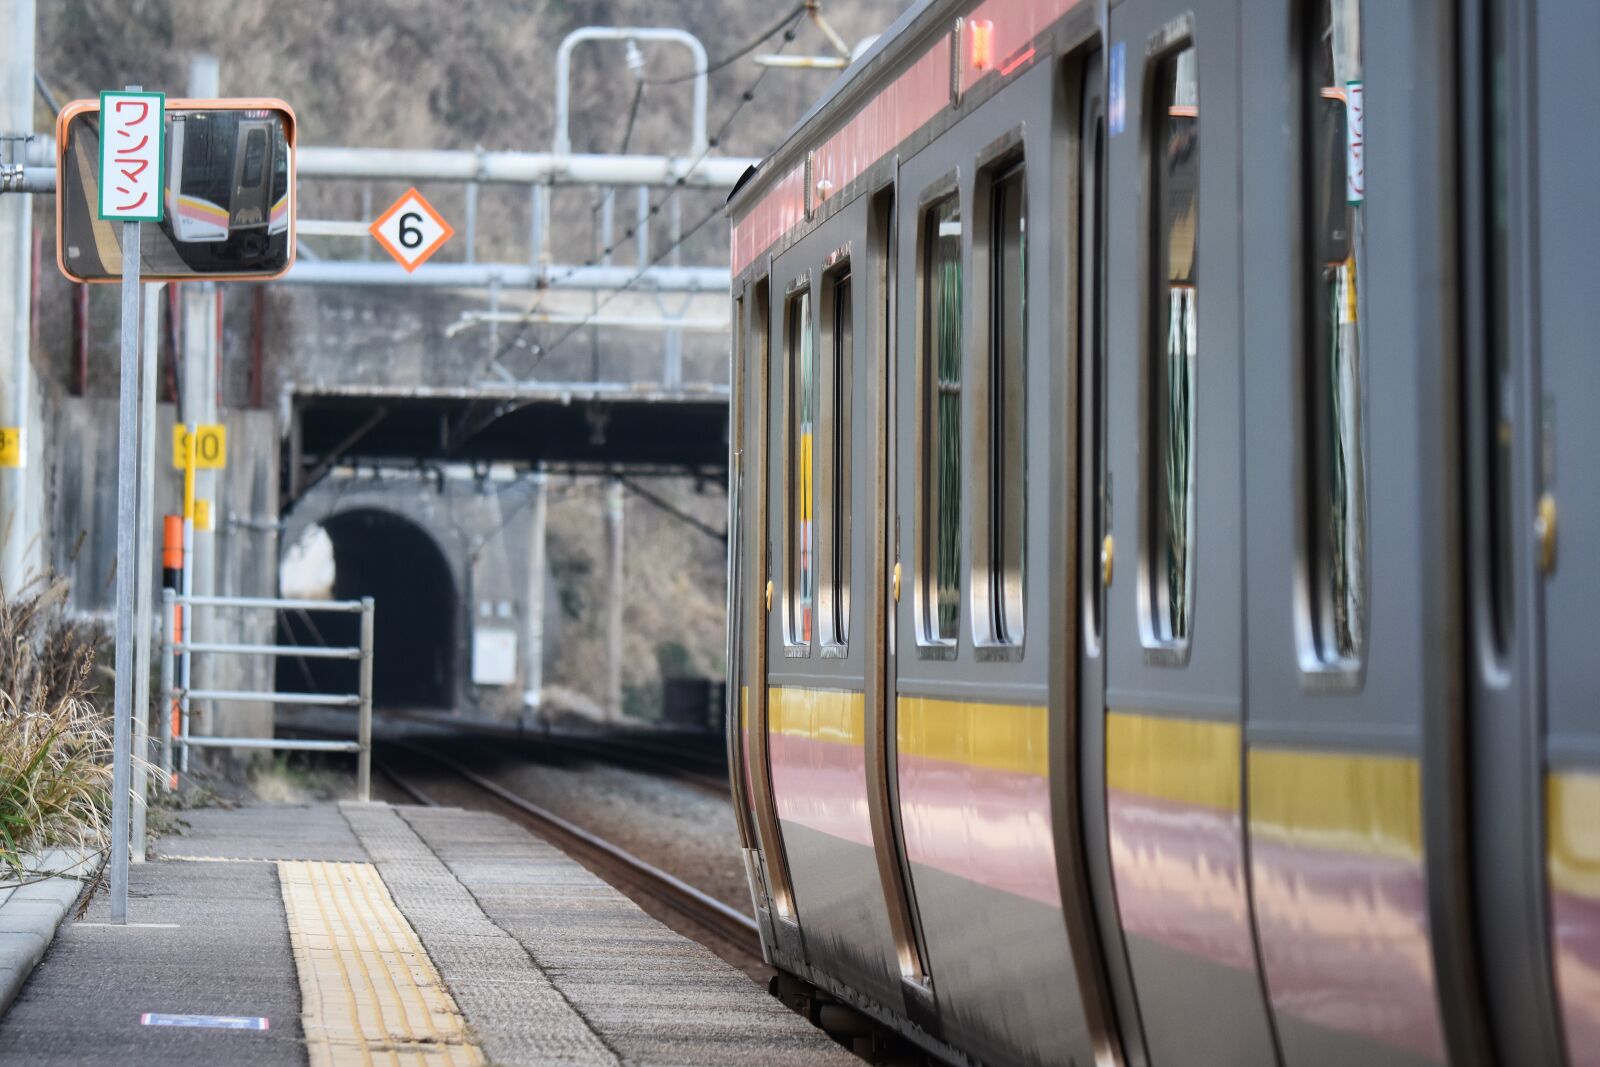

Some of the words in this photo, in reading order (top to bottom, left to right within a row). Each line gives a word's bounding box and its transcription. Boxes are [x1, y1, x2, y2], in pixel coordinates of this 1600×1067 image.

[114, 101, 149, 211] ワンマン
[399, 212, 424, 249] 6
